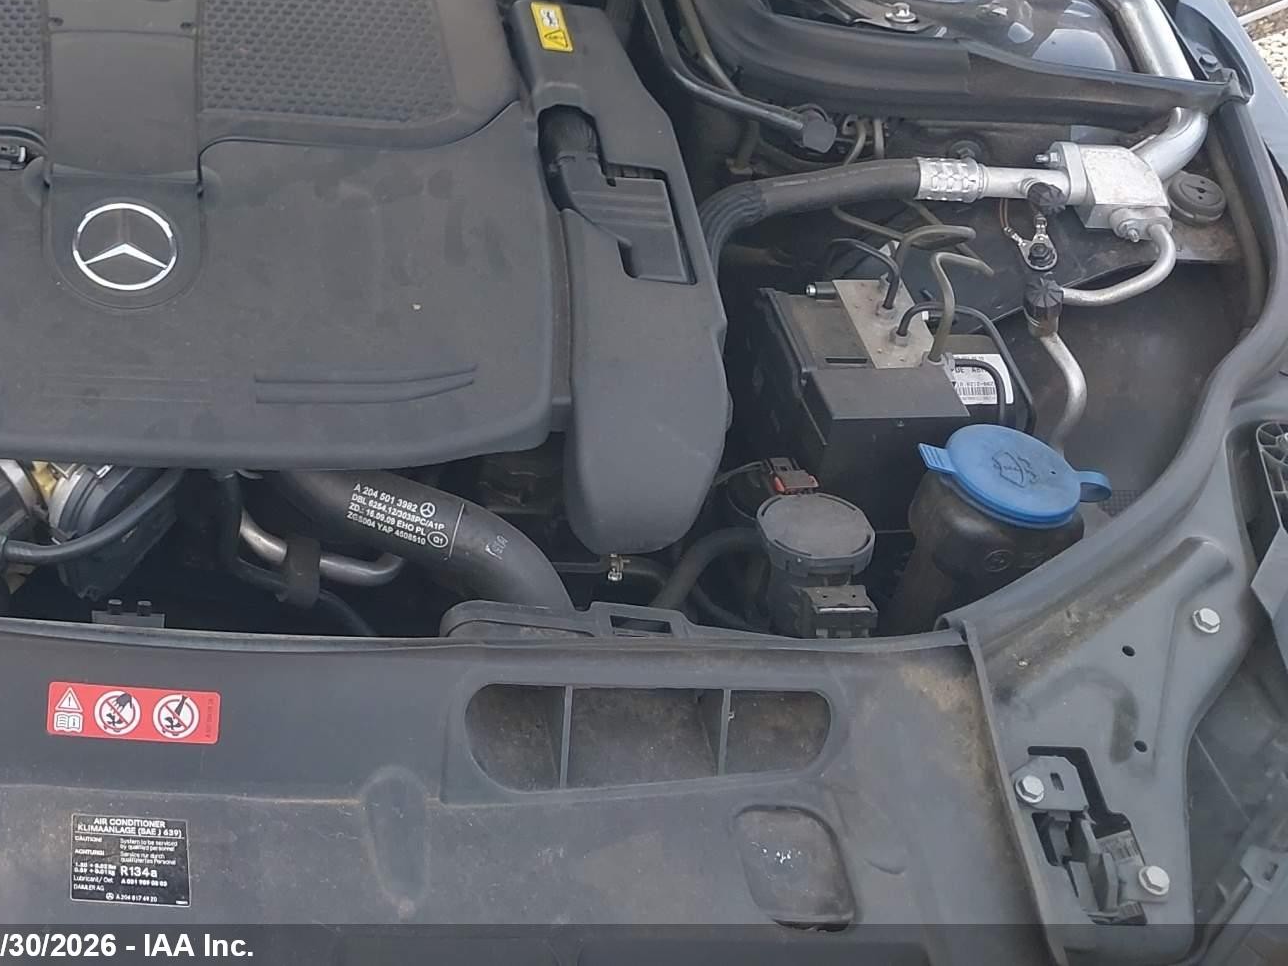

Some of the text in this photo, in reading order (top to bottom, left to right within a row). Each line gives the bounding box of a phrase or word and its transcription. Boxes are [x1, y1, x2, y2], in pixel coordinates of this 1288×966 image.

[352, 494, 367, 505] DBL
[354, 484, 418, 512] A 204 501 3982
[377, 523, 394, 533] YAP
[415, 526, 426, 536] PL
[109, 819, 165, 828] CONDITIONER
[78, 824, 136, 834] KLIMAANLAGE
[163, 829, 182, 838] 639)
[120, 837, 140, 846] System
[120, 865, 158, 878] R134a
